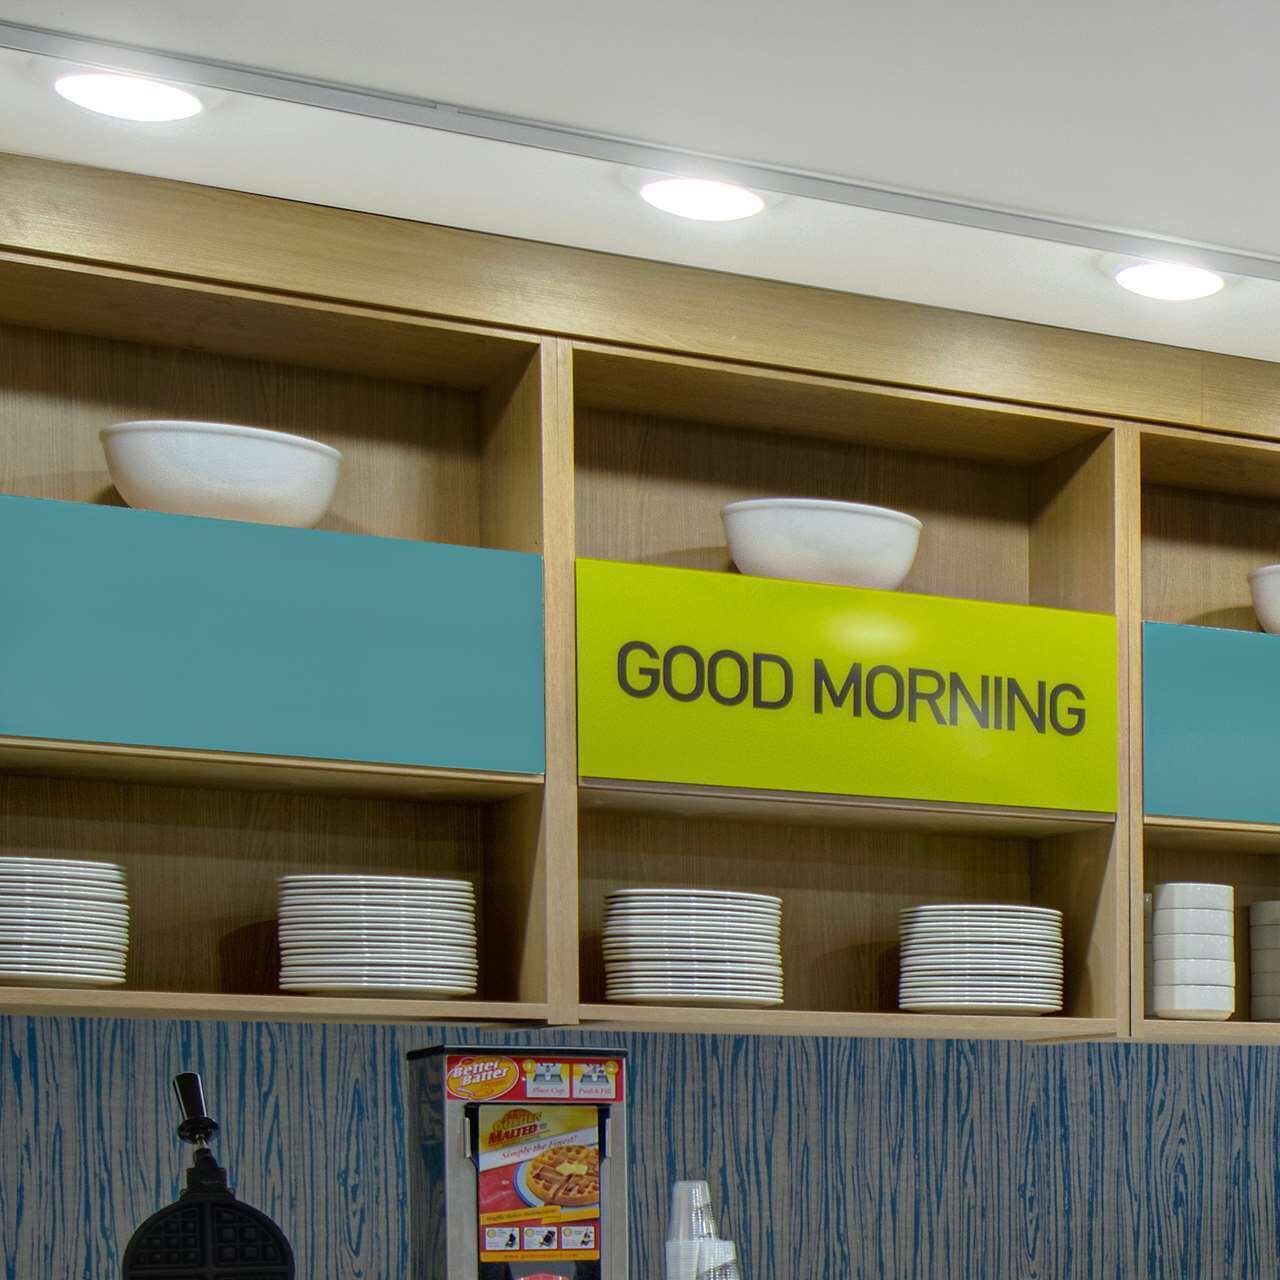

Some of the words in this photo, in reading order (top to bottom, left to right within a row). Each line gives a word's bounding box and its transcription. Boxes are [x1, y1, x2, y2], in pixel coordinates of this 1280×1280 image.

[616, 640, 794, 711] GOOD
[813, 658, 1087, 737] MORNING
[452, 1060, 499, 1079] Better
[462, 1067, 509, 1087] Batter
[488, 1123, 538, 1145] MALTED
